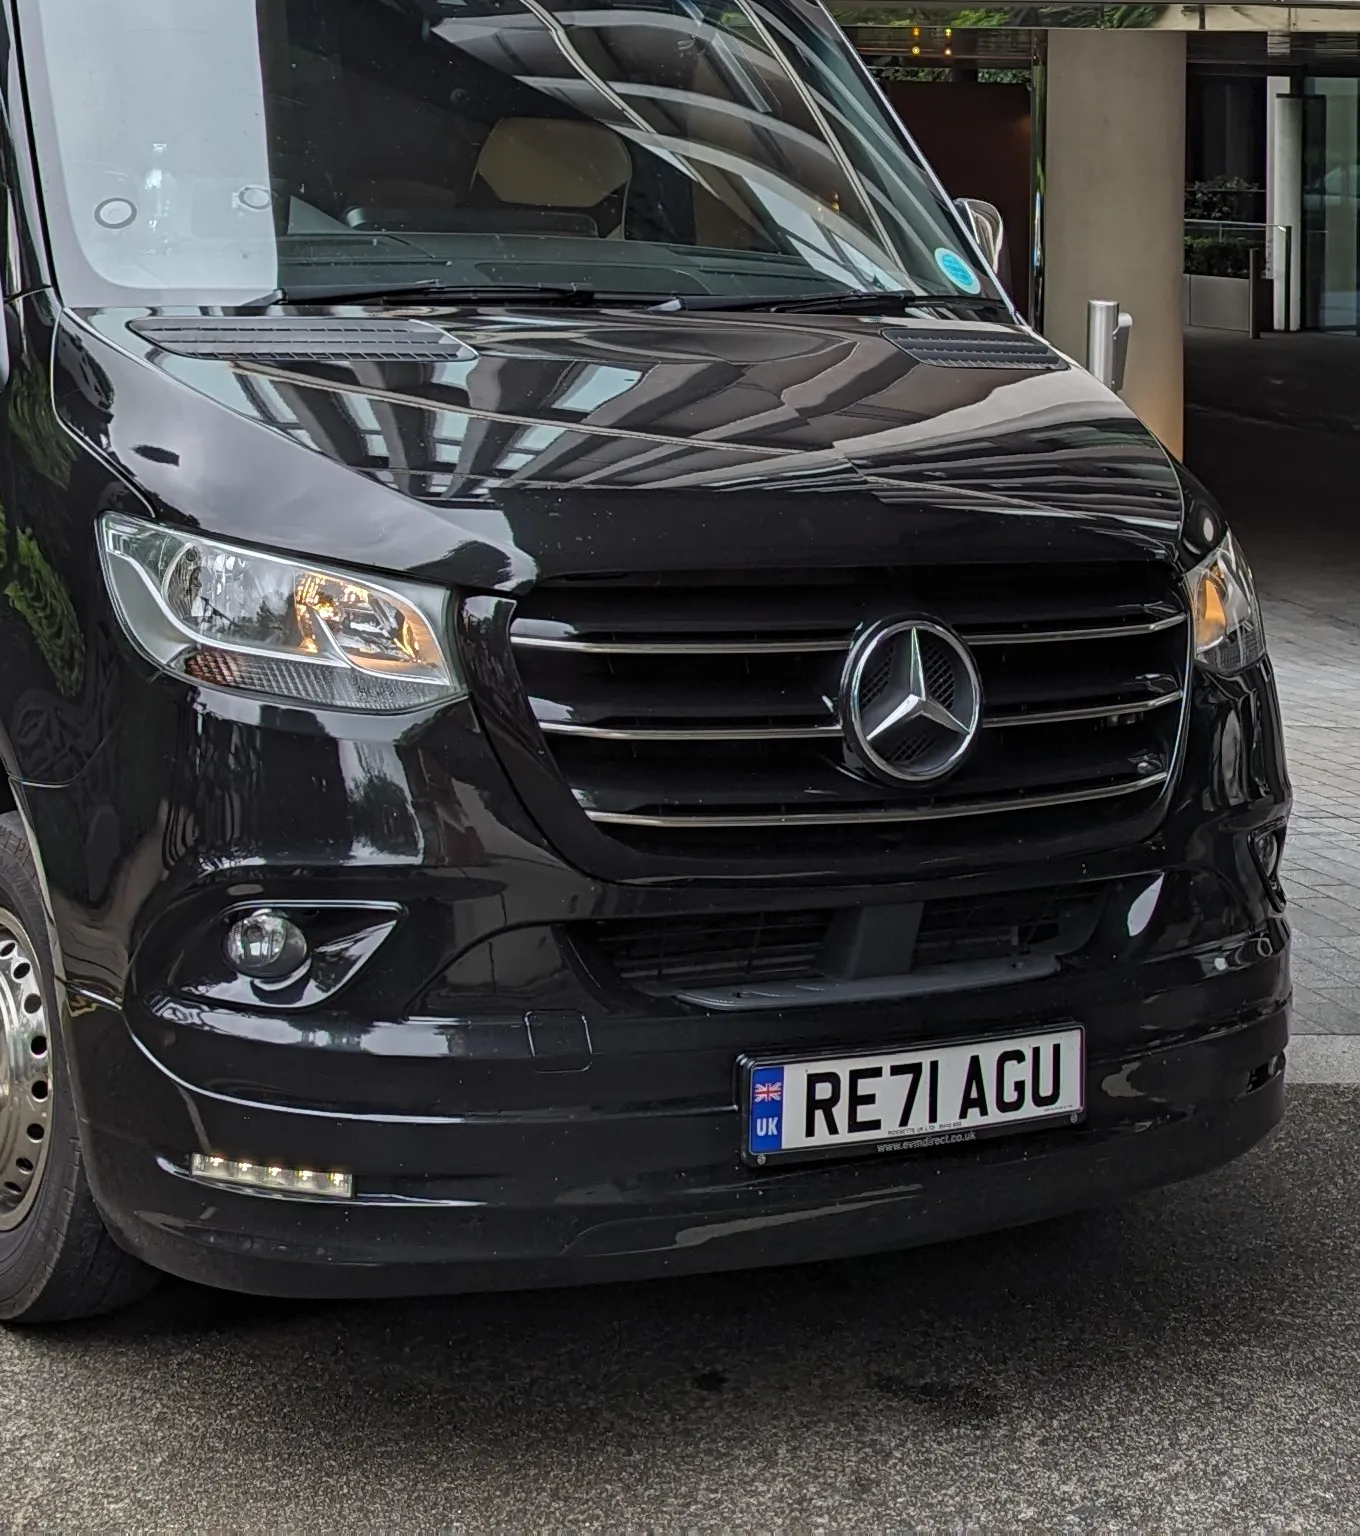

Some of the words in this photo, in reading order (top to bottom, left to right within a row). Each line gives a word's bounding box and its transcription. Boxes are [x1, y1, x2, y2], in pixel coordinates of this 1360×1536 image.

[804, 1059, 939, 1138] RE71
[958, 1042, 1062, 1120] AGU
[756, 1116, 779, 1137] UK
